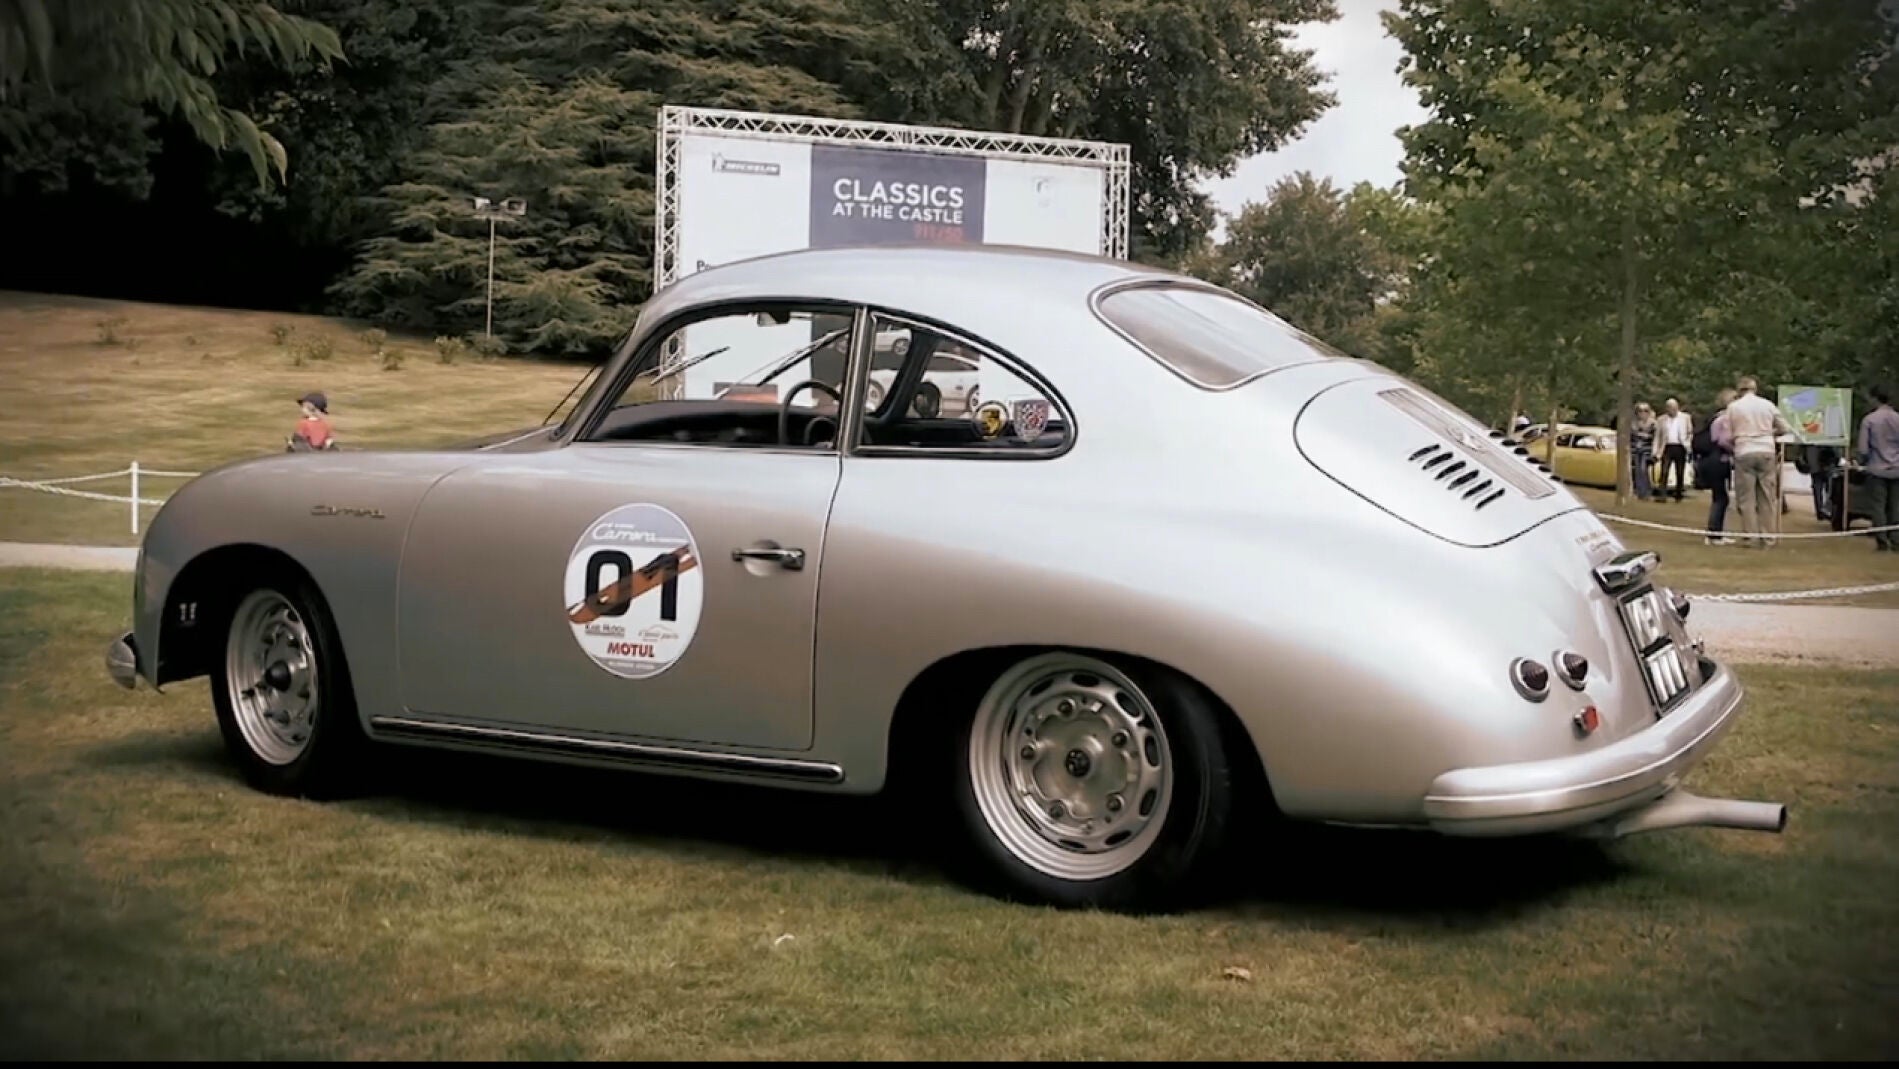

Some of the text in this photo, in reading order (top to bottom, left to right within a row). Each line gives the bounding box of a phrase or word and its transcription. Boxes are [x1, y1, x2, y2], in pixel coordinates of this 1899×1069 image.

[833, 178, 964, 208] CLASSICS
[832, 202, 963, 225] AT THE CASTLE
[585, 550, 680, 621] 01
[607, 641, 656, 658] MOTUL
